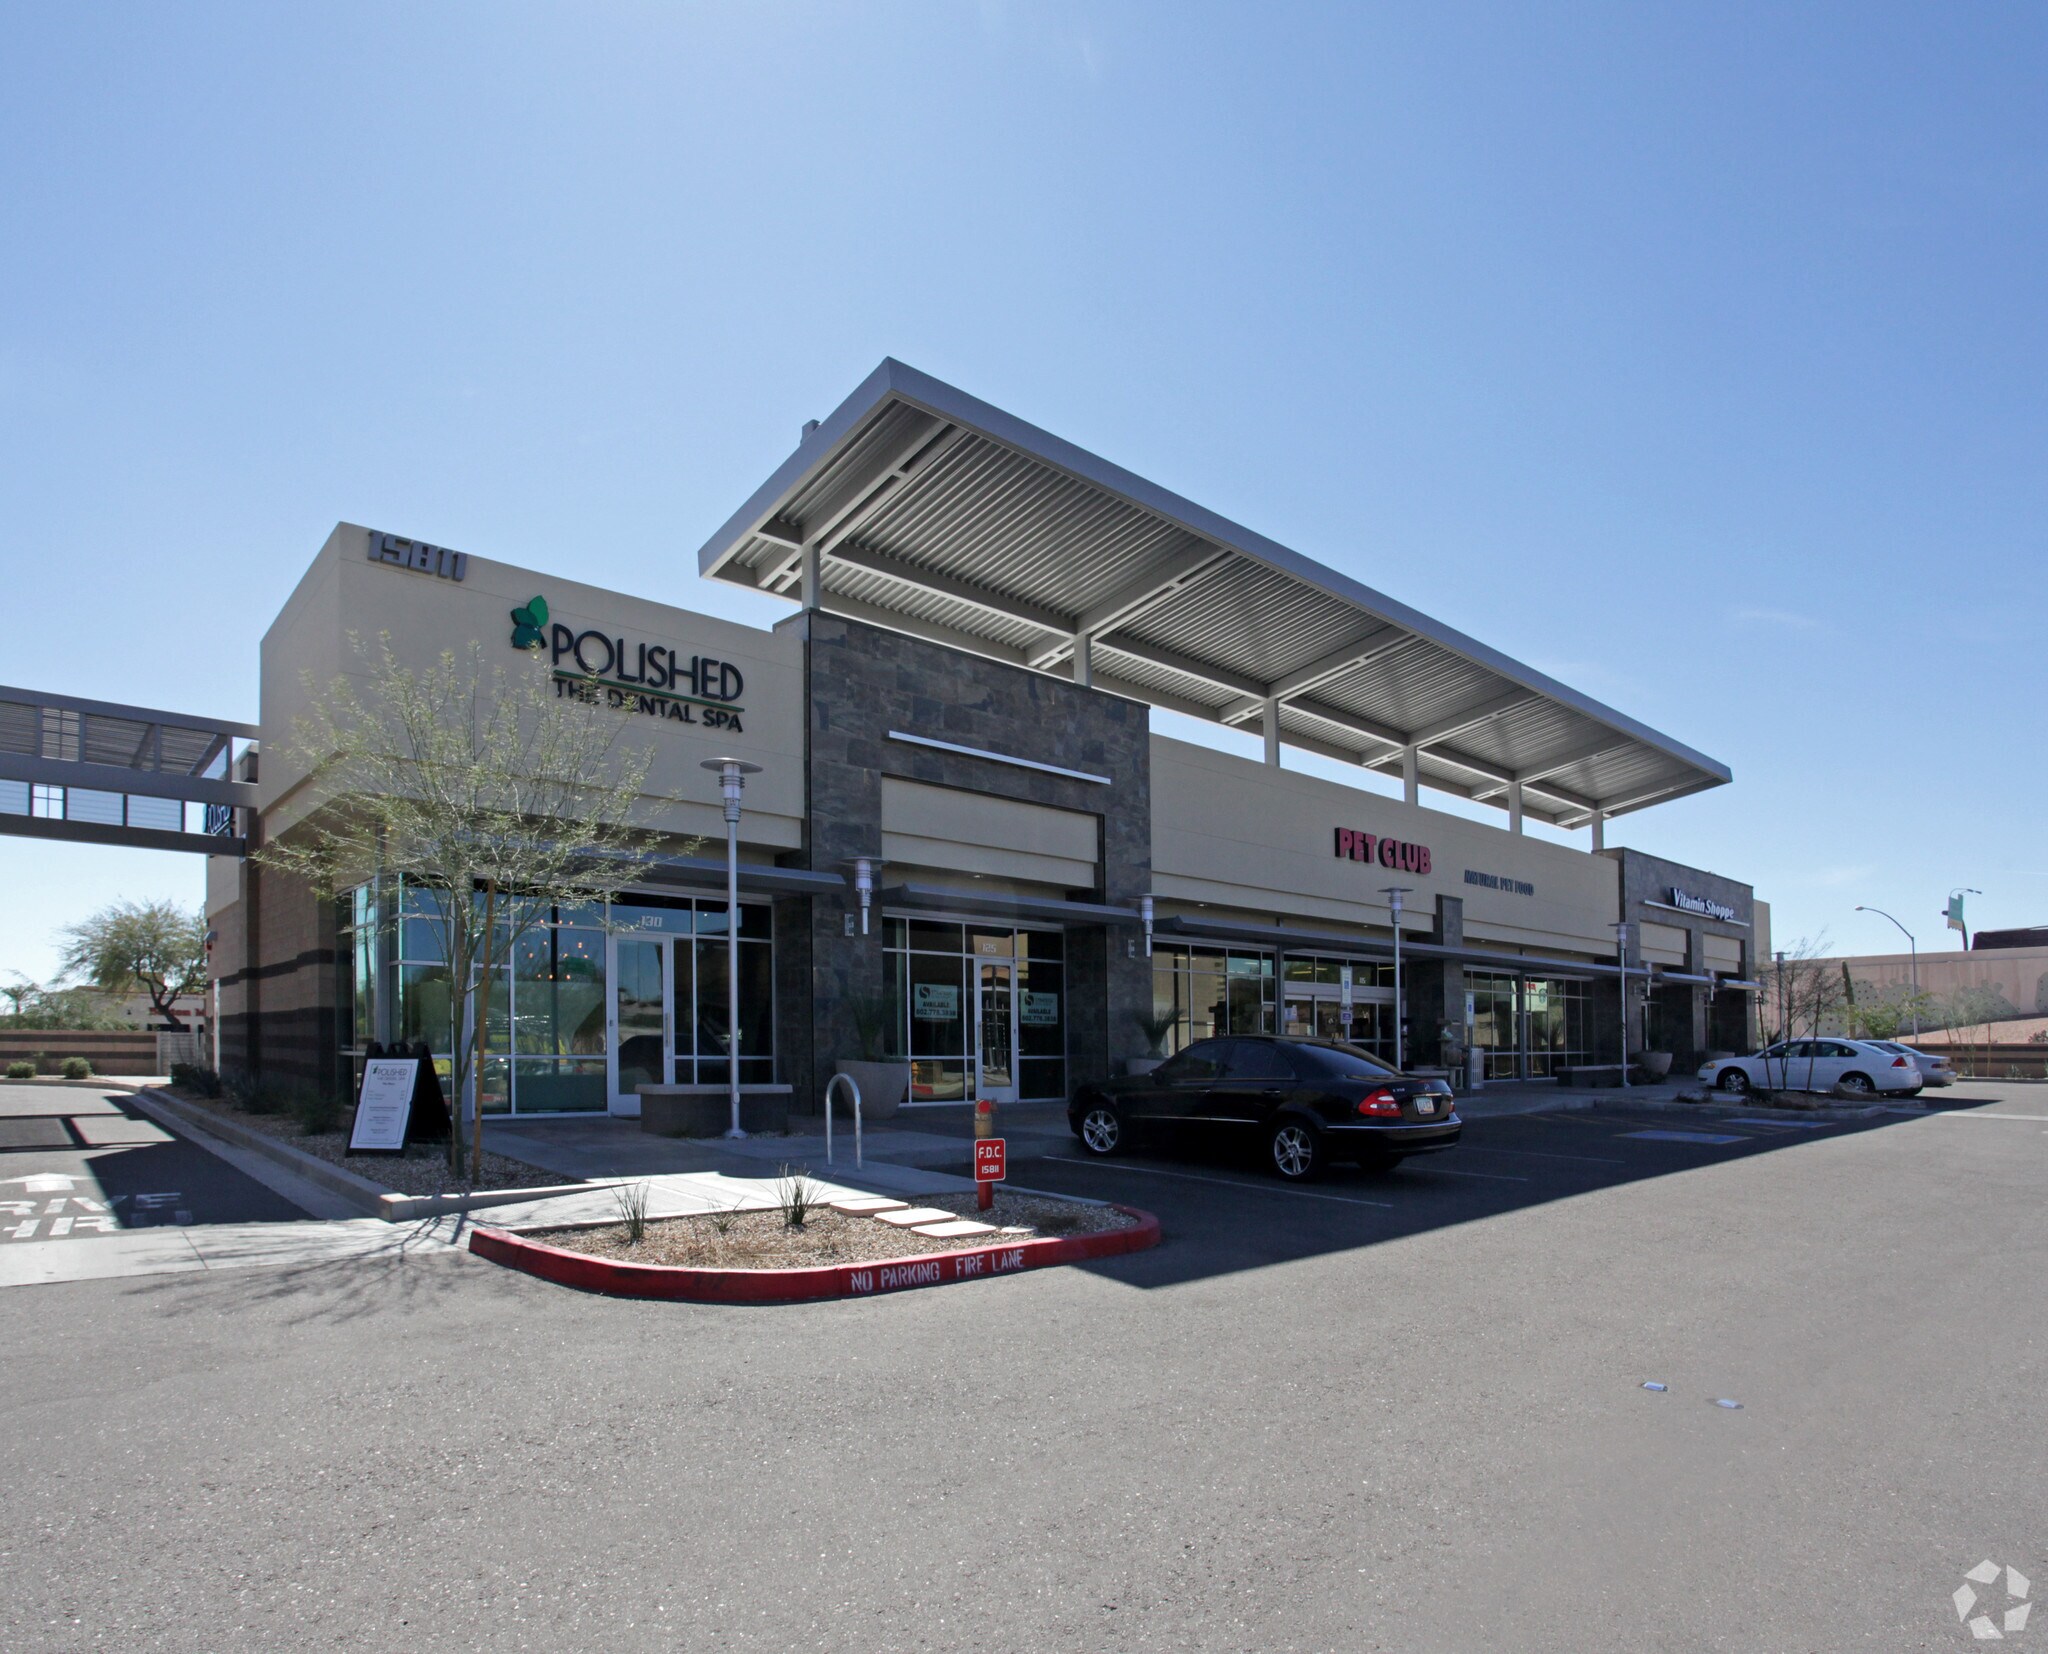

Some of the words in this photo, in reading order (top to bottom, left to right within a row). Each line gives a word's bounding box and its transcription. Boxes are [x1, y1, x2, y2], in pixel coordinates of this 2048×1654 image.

[367, 529, 467, 582] 15811
[552, 623, 744, 701] POLISHED
[702, 708, 744, 733] SPA
[1334, 827, 1377, 863] PET
[1378, 838, 1432, 874] CLUB
[1500, 877, 1514, 892] PET
[1671, 887, 1705, 912] Vitamin
[1705, 899, 1734, 919] Shoppe
[641, 915, 663, 928] 130
[981, 943, 997, 953] 125
[378, 1068, 408, 1076] POLISHED
[978, 1146, 1002, 1159] F.D.C.
[981, 1164, 1000, 1174] 15811
[851, 1270, 873, 1293] NO
[880, 1261, 940, 1289] PARKING
[955, 1253, 985, 1278] FIRE
[991, 1248, 1025, 1273] LANE
